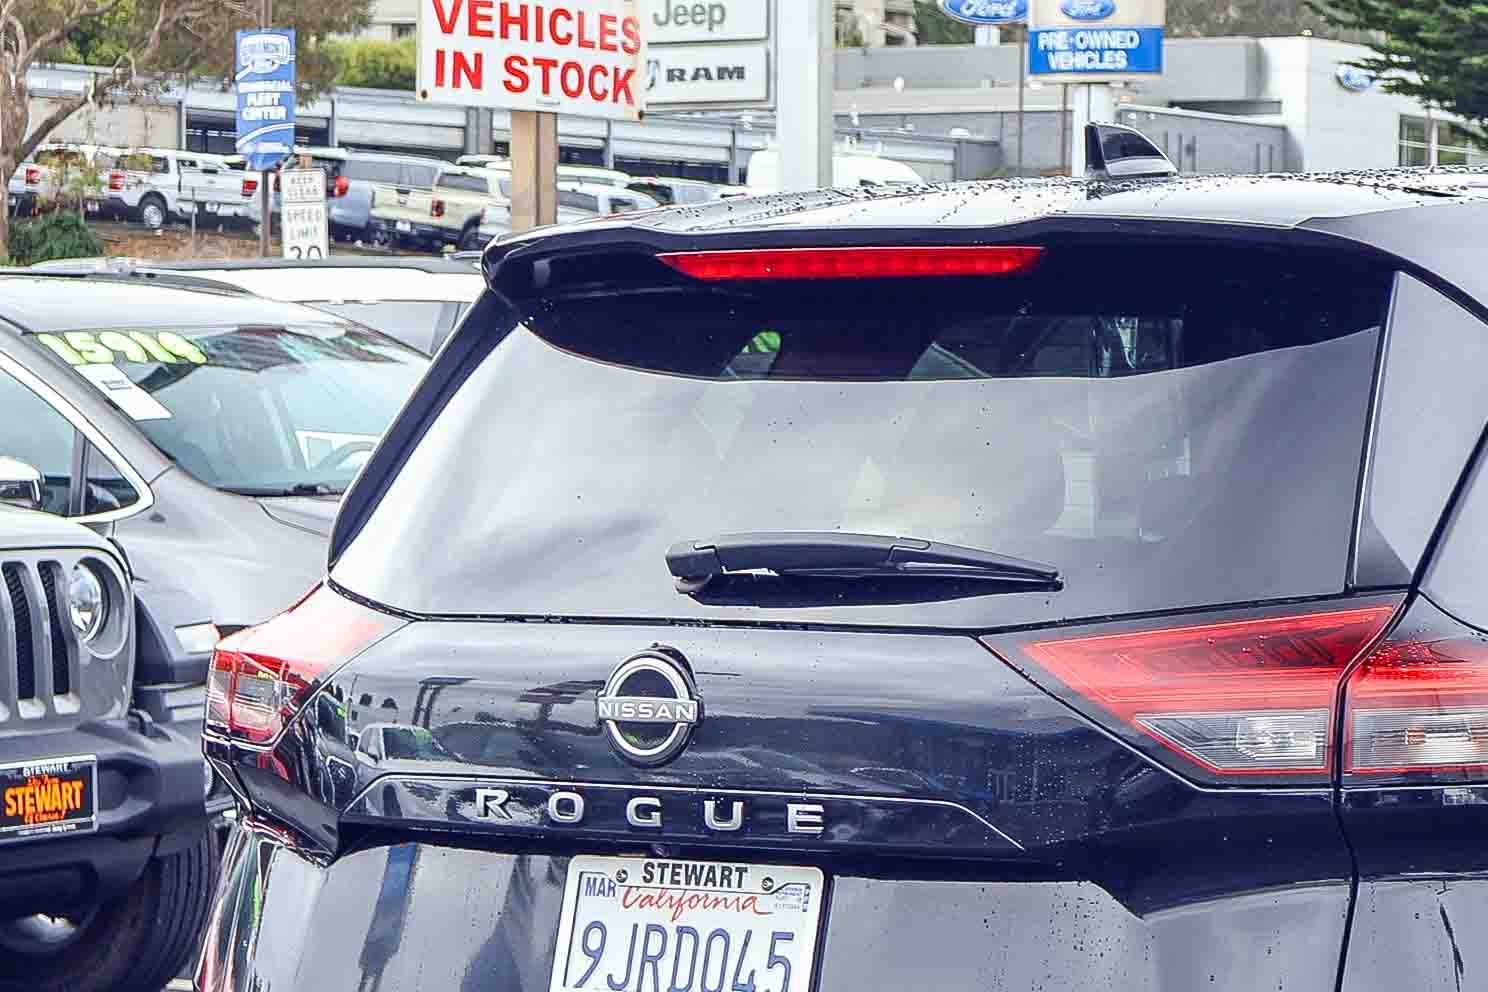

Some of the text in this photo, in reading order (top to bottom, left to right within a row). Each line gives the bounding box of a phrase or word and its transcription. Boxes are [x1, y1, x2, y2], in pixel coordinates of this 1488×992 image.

[433, 0, 641, 54] VEHICLES
[653, 0, 726, 30] Jeep
[666, 66, 746, 82] RAM
[1048, 51, 1128, 70] VEHICLES
[434, 49, 635, 105] IN STOCK
[599, 702, 695, 720] NISSAN
[5, 780, 83, 816] STEWART
[475, 787, 825, 834] ROGUE
[584, 877, 617, 898] MAR
[642, 861, 748, 888] STEWART
[622, 886, 773, 921] California
